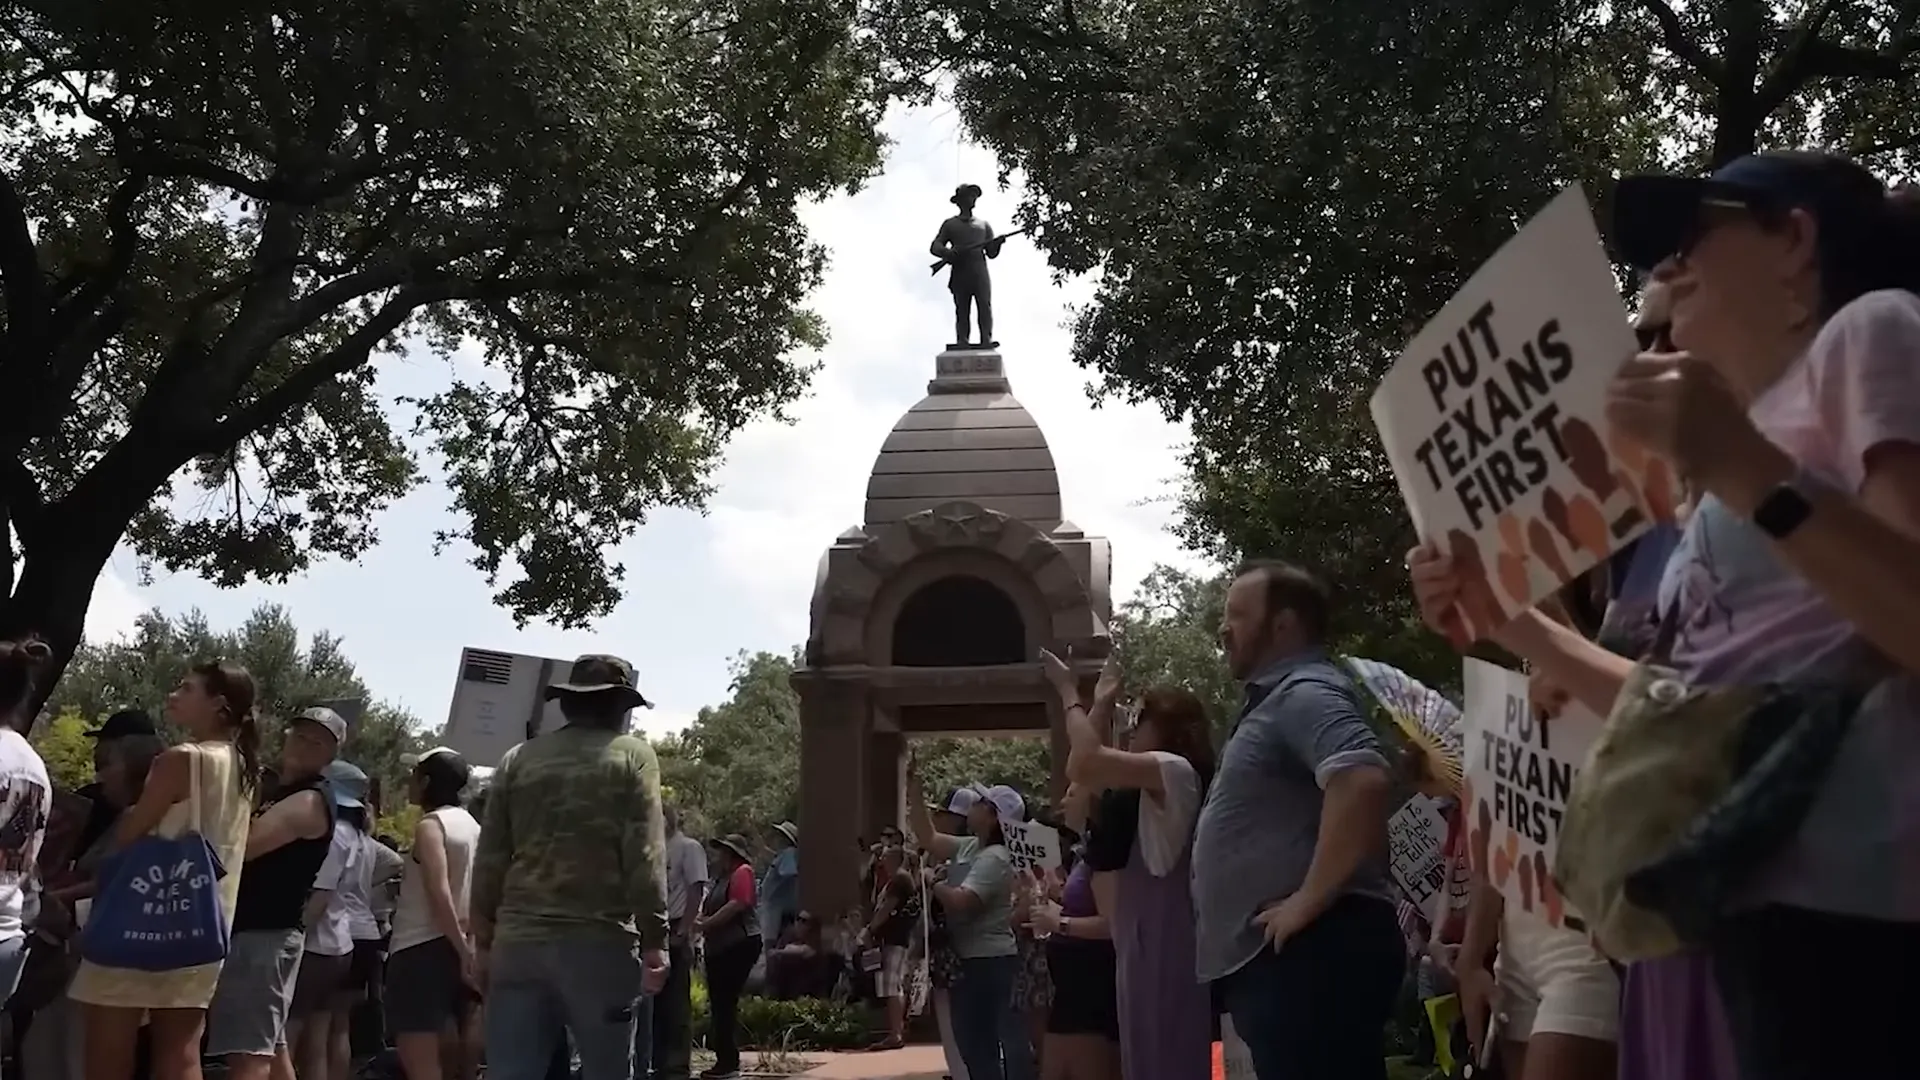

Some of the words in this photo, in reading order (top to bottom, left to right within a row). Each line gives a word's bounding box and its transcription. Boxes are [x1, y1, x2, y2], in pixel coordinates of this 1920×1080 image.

[1421, 300, 1500, 414] PUT
[1415, 318, 1573, 492] TEXANS
[1454, 402, 1570, 531] FIRST
[1482, 729, 1579, 805] TEXAN
[1405, 803, 1422, 819] To
[1494, 781, 1562, 845] FIRST
[1405, 817, 1432, 843] Able
[1010, 853, 1037, 870] RST
[1389, 858, 1407, 874] To
[1402, 843, 1424, 863] Tell
[156, 883, 181, 900] AE
[1411, 881, 1432, 904] I
[143, 898, 191, 915] MAIC
